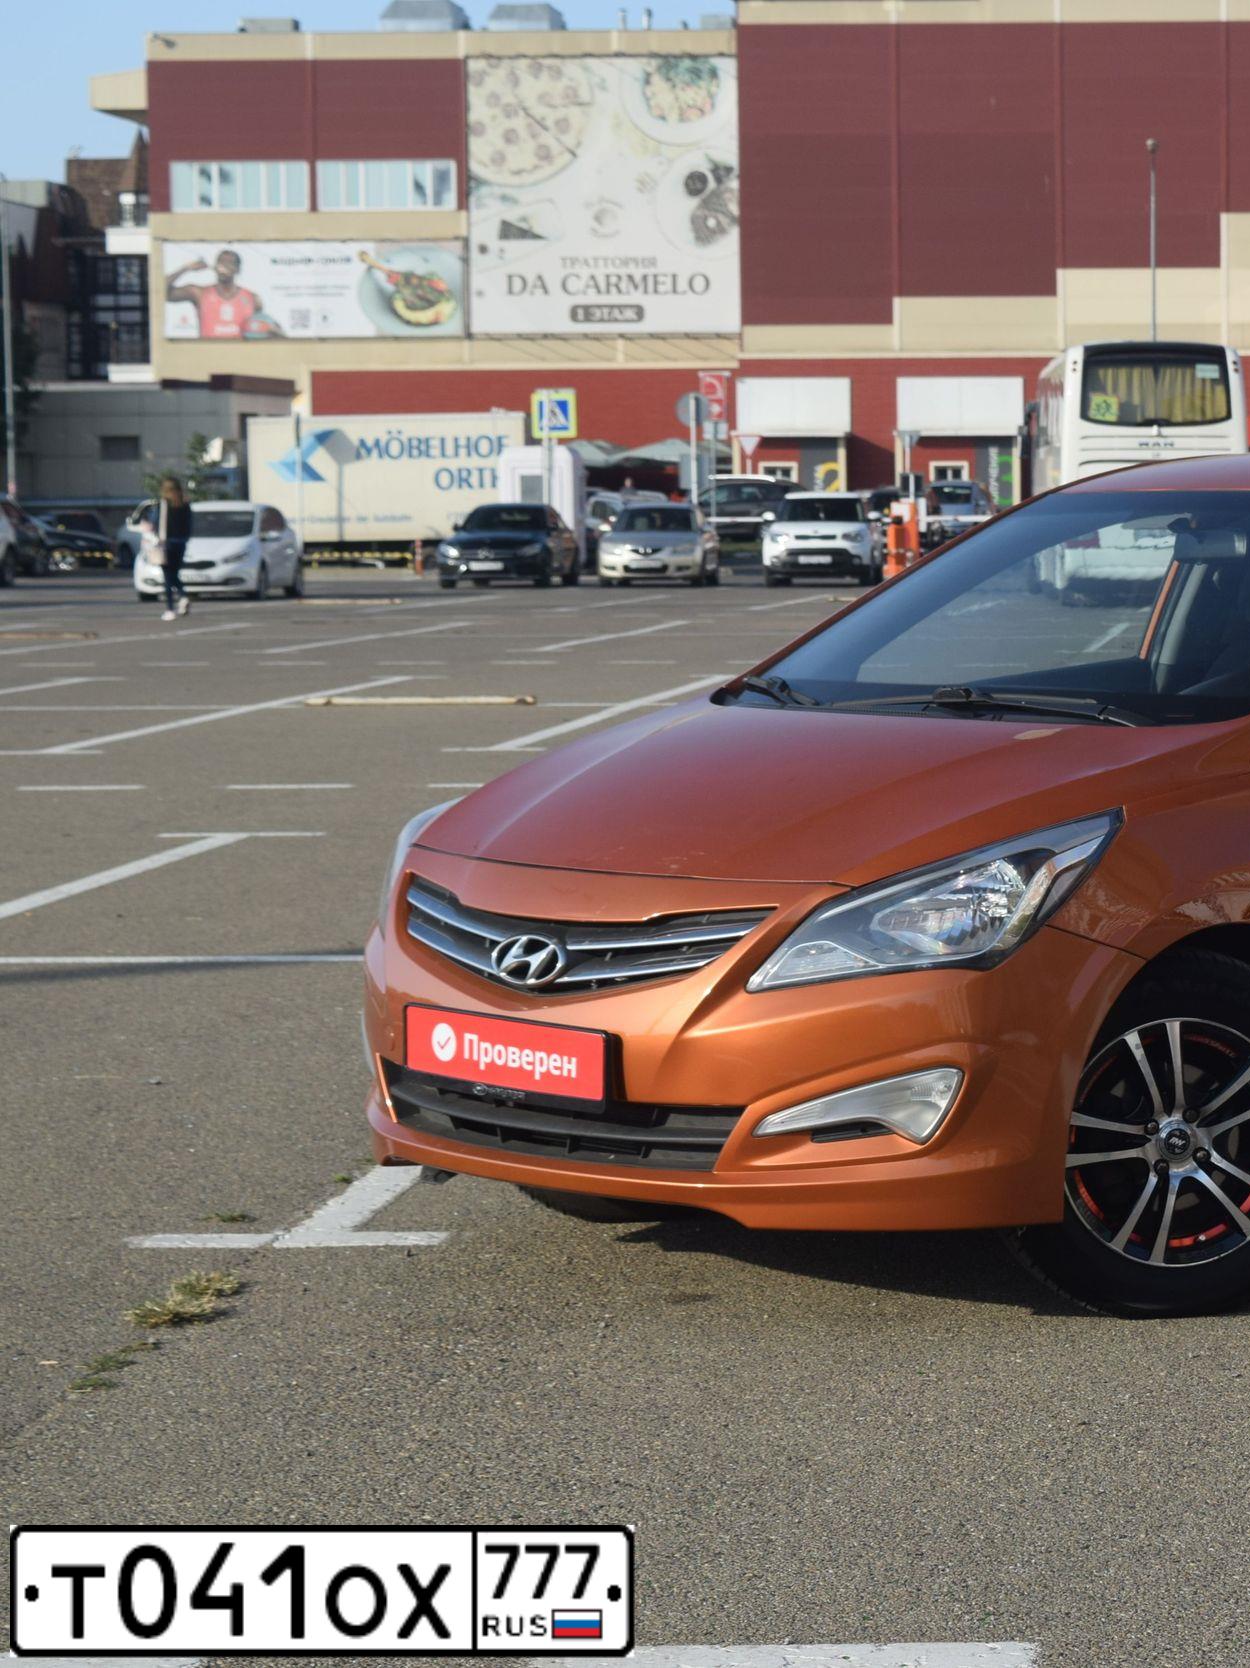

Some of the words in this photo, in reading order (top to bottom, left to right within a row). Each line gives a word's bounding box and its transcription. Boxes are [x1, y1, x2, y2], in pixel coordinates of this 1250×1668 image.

[560, 256, 658, 269] ТРАТТОРИЯ
[506, 273, 549, 296] DA
[561, 273, 710, 296] CARMELO
[575, 307, 585, 321] 1
[590, 307, 639, 321] ЭТАЖ
[355, 429, 510, 460] MÖBELHOF
